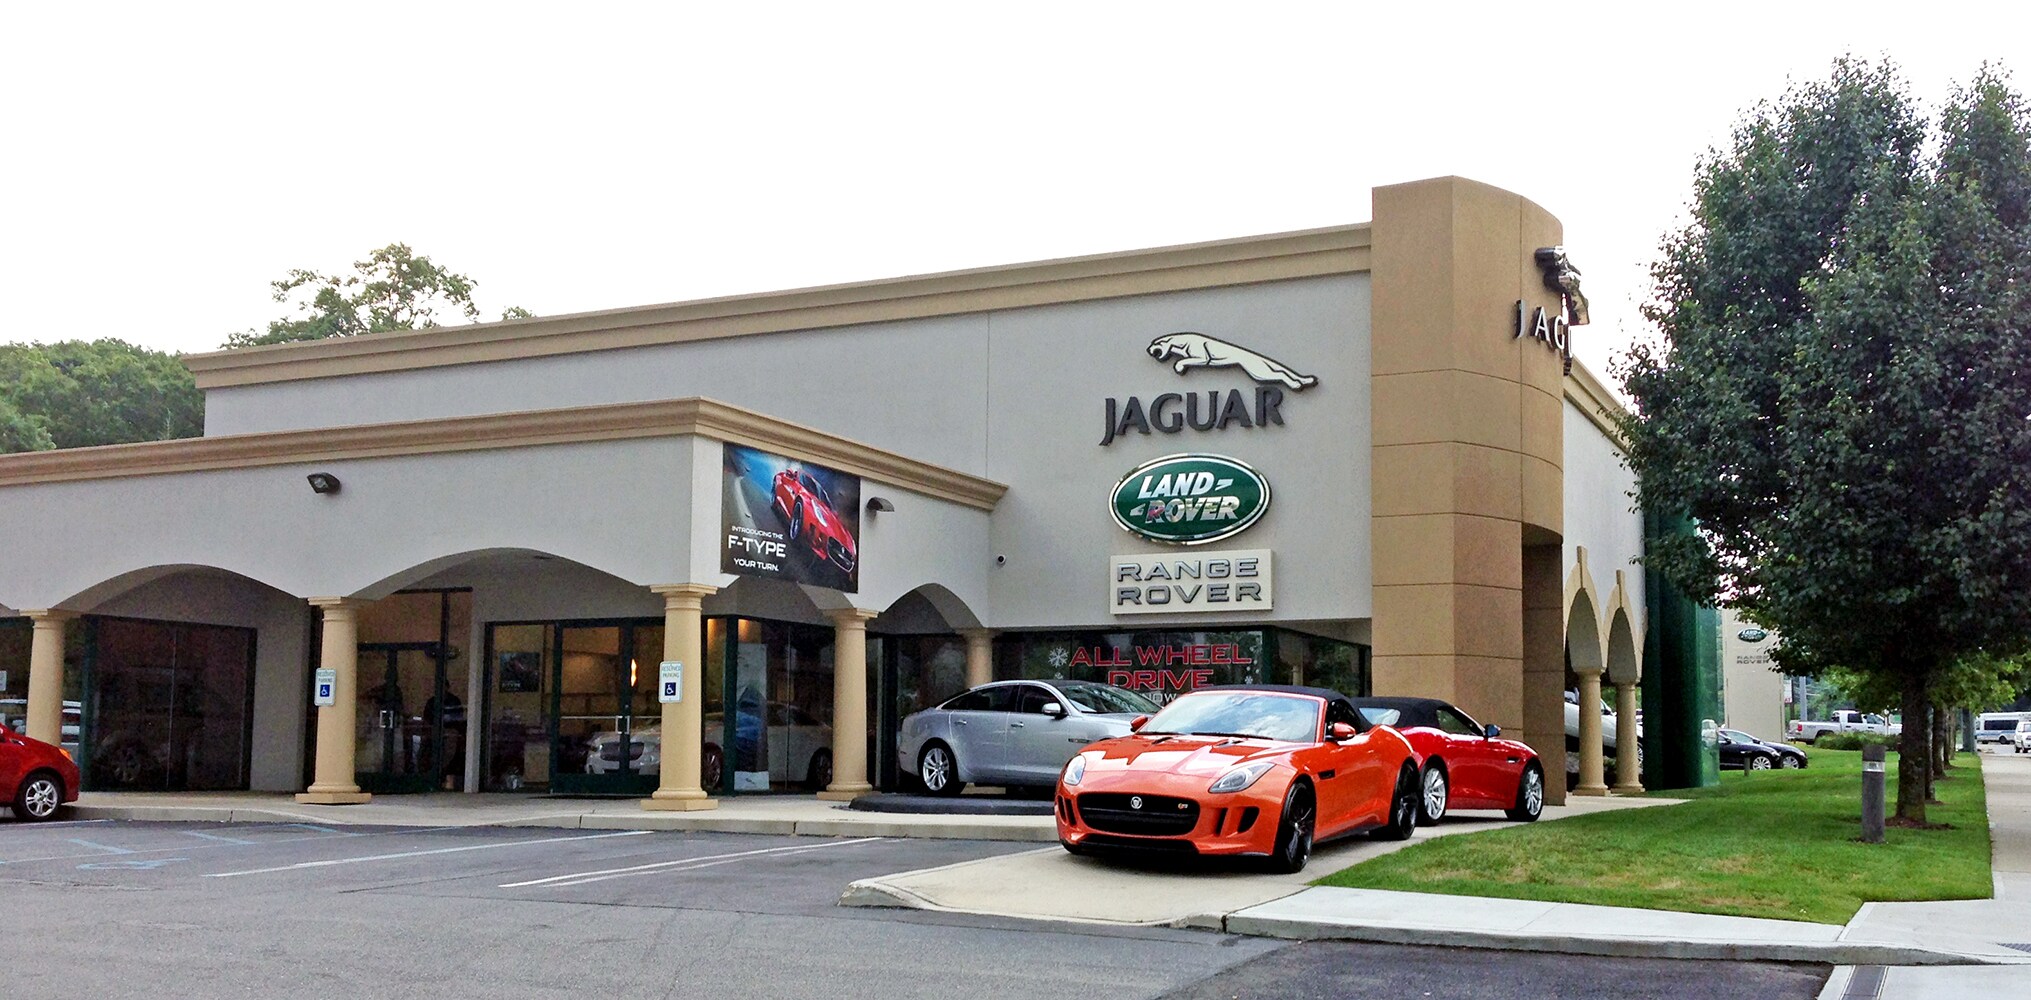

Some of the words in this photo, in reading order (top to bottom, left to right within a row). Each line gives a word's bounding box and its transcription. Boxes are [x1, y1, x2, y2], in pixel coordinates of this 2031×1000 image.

[1513, 299, 1573, 359] JAG
[1099, 386, 1285, 446] JAGUAR
[1137, 472, 1215, 499] LAND
[1145, 496, 1241, 524] ROVER
[731, 525, 772, 538] INTRODUCING
[772, 532, 784, 540] THE
[728, 534, 787, 558] F-TYPE
[733, 557, 756, 568] YOUR
[1117, 558, 1259, 582] RANGE
[1117, 582, 1262, 606] ROVER
[1069, 645, 1132, 667] ALL
[1135, 643, 1252, 666] WHEEL
[1108, 669, 1214, 690] DRIVE
